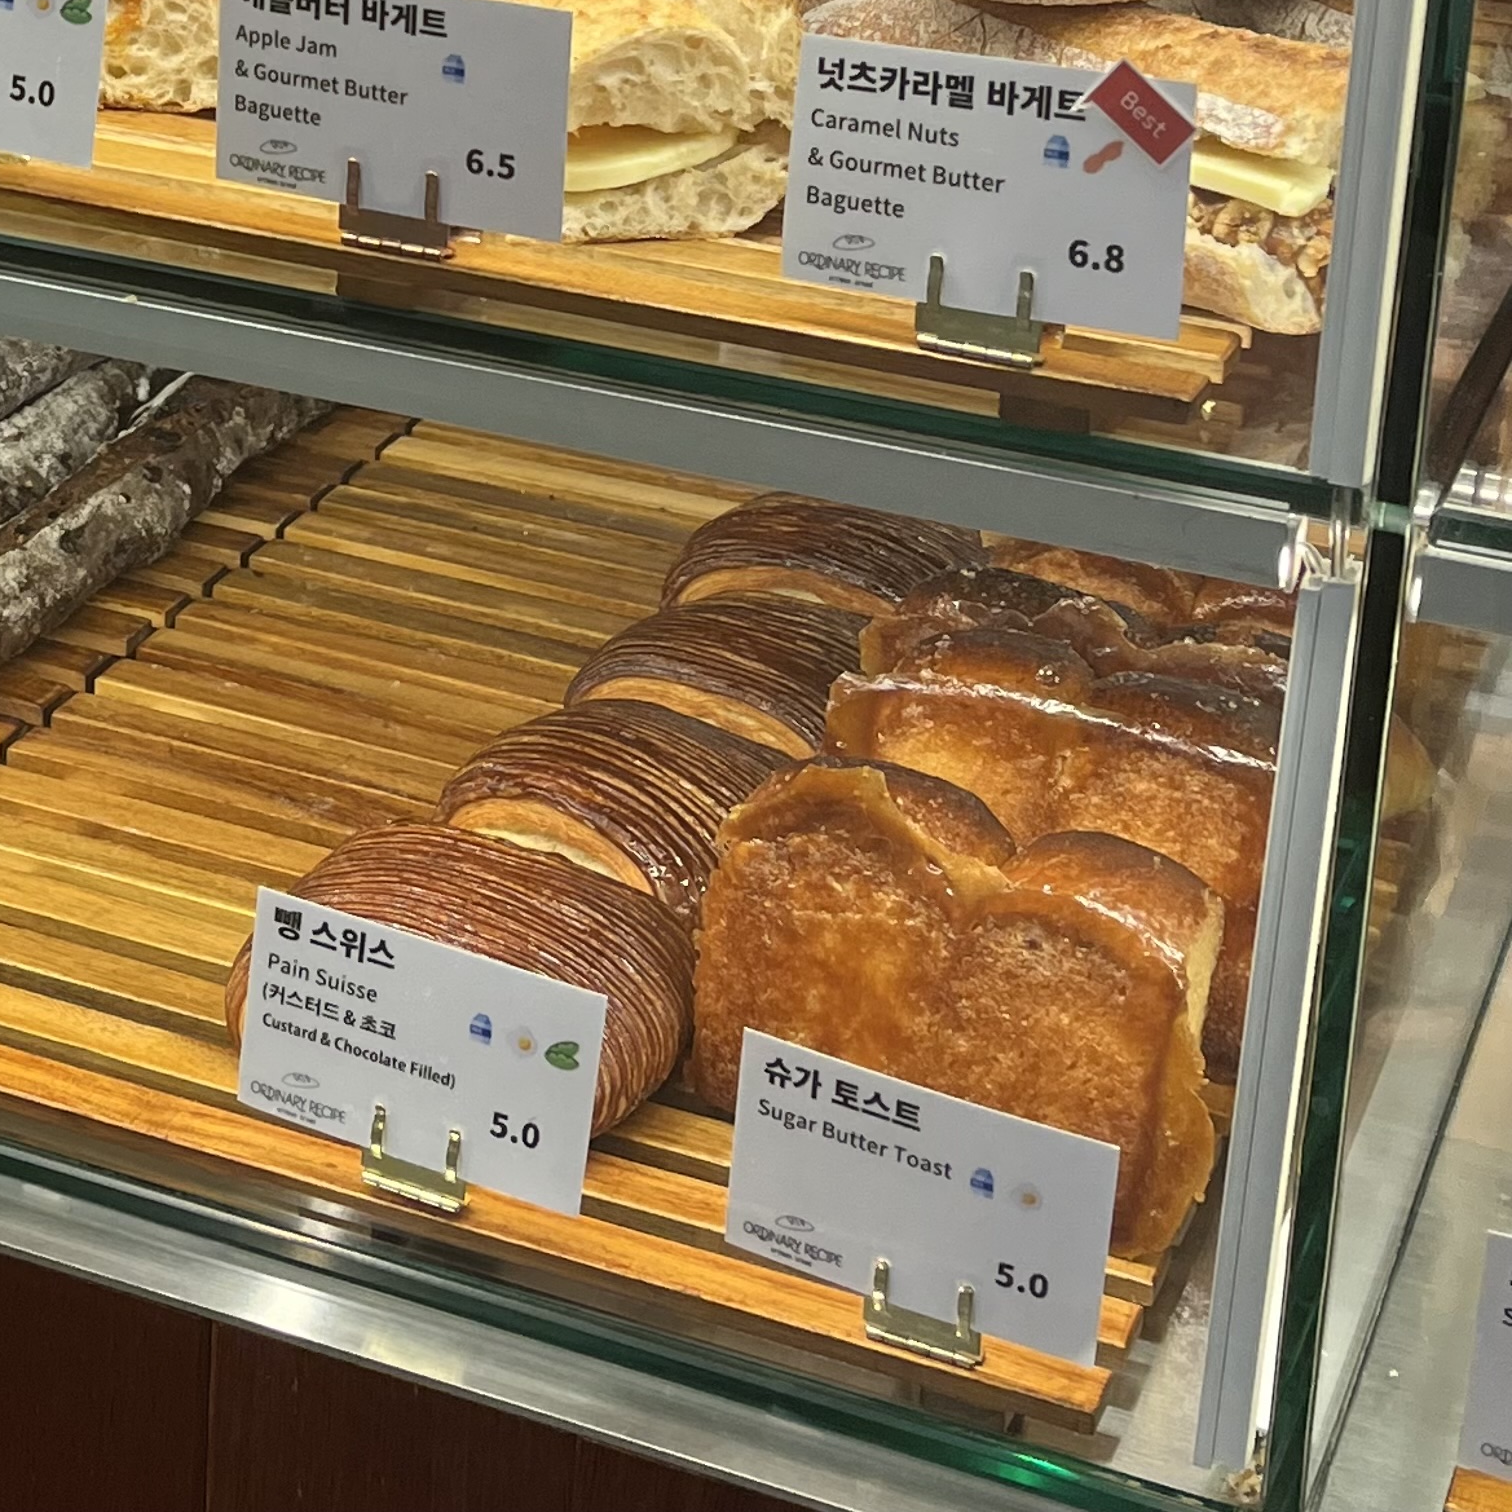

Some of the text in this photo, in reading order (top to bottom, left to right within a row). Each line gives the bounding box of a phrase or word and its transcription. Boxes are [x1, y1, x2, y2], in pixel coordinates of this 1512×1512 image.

[235, 25, 337, 57] Apple Jam
[10, 74, 55, 107] 5.0
[235, 60, 408, 105] & Gourmet Butter
[818, 57, 1087, 122] 넛츠카라멜 바게트
[235, 94, 321, 126] Baguette
[811, 108, 959, 147] Caramel Nuts
[1120, 90, 1169, 140] Best
[466, 149, 515, 180] 6.5
[808, 147, 1005, 193] & Gourmet Butter
[807, 185, 905, 218] Baguette
[1068, 240, 1125, 274] 6.8
[274, 907, 396, 970] 뺑 스위스
[268, 953, 378, 1003] Pain Suisse
[262, 982, 397, 1040] (커스터드 & 초코
[262, 1012, 456, 1089] Custard & Chocolate Filled)
[309, 1100, 346, 1124] RECIPE
[764, 1057, 921, 1132] 슈가 토스트
[490, 1112, 540, 1149] 5.0
[758, 1099, 952, 1181] Sugar Butter Toast
[995, 1262, 1049, 1299] 5.0
